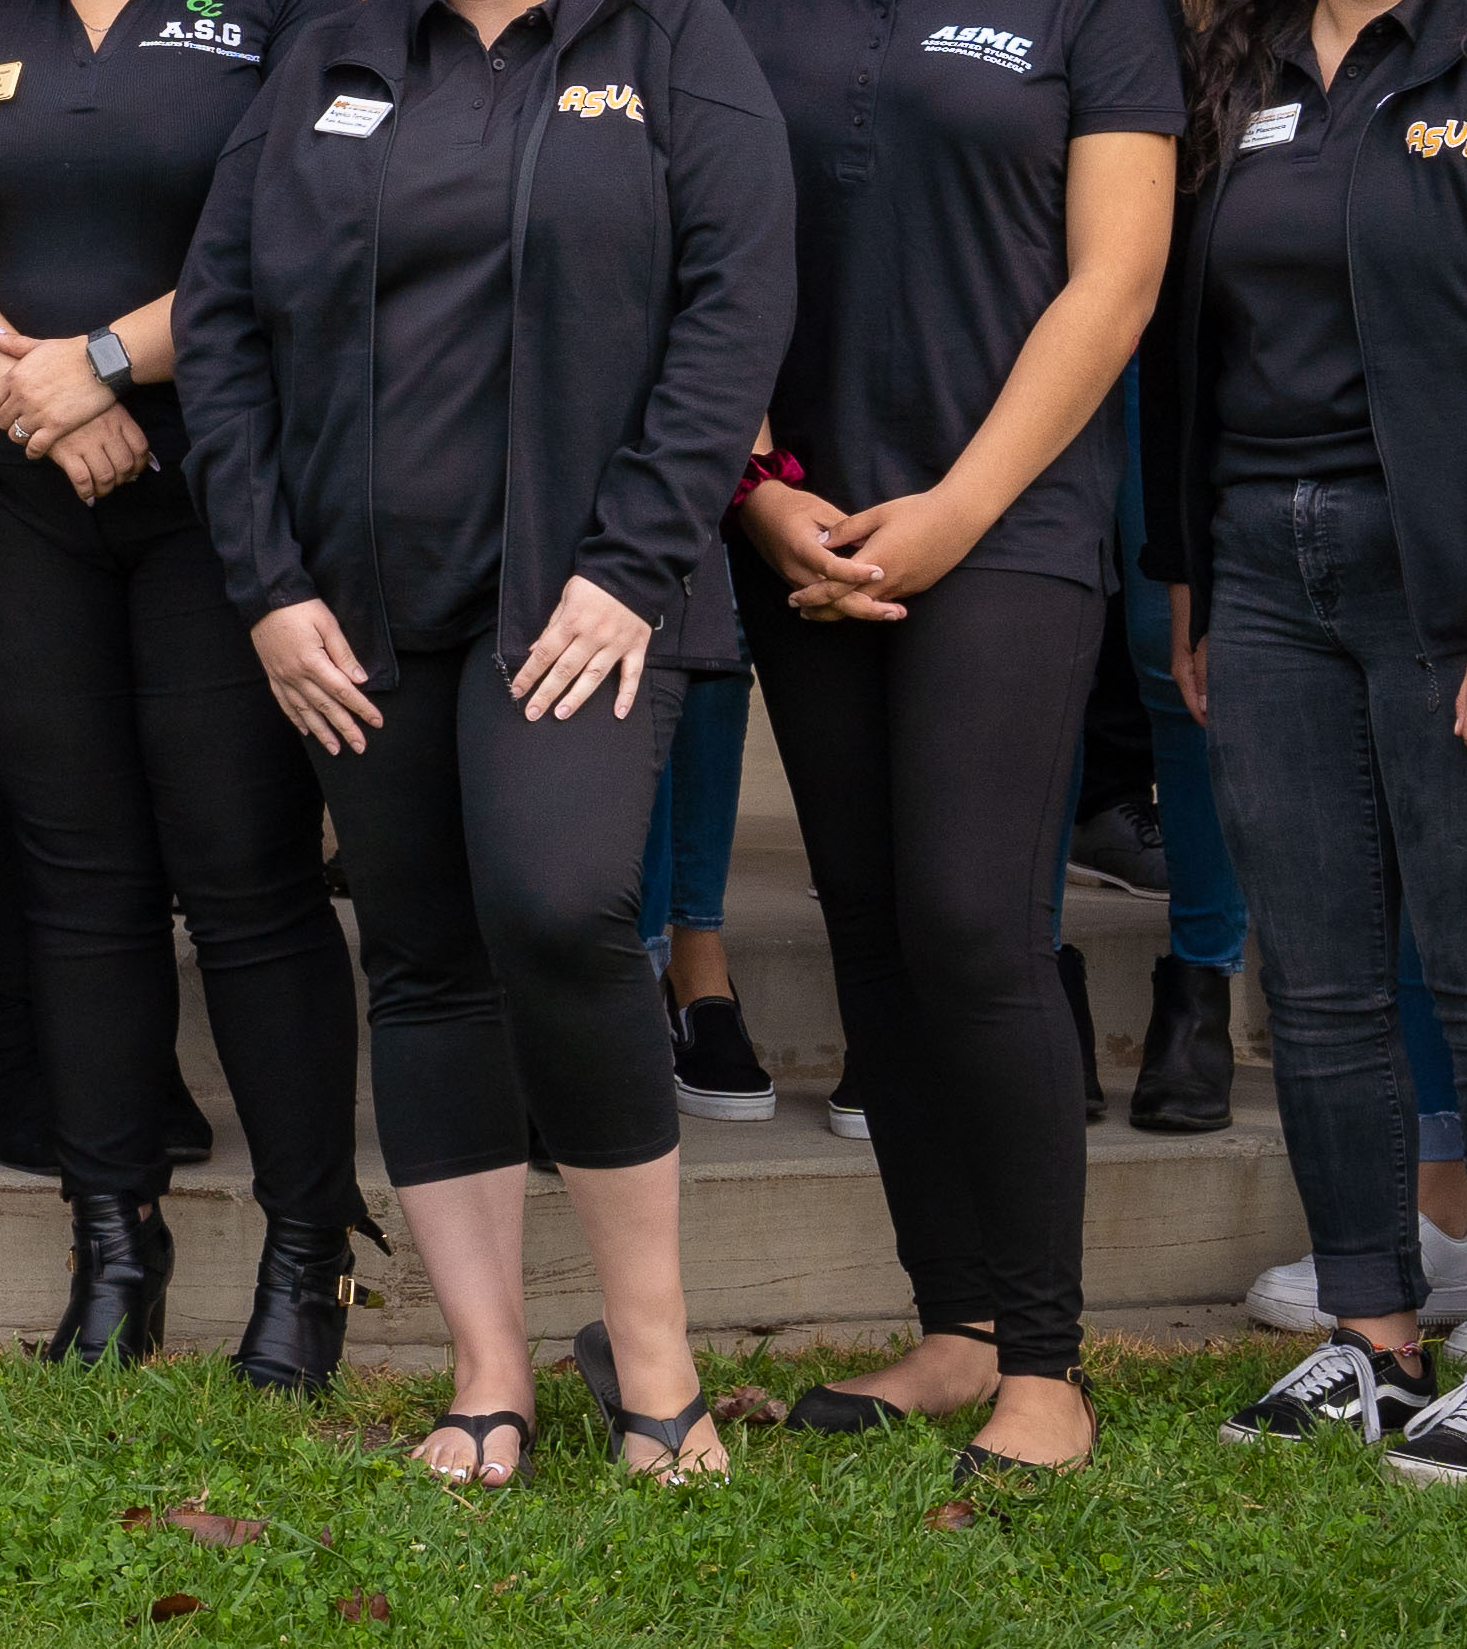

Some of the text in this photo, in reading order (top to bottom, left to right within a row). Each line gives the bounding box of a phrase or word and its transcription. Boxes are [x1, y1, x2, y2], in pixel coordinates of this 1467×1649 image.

[921, 39, 1032, 69] ASSOCIATED STUDENTS
[928, 25, 1033, 56] ASMC
[924, 46, 1025, 74] MOORPARK COLLEGE
